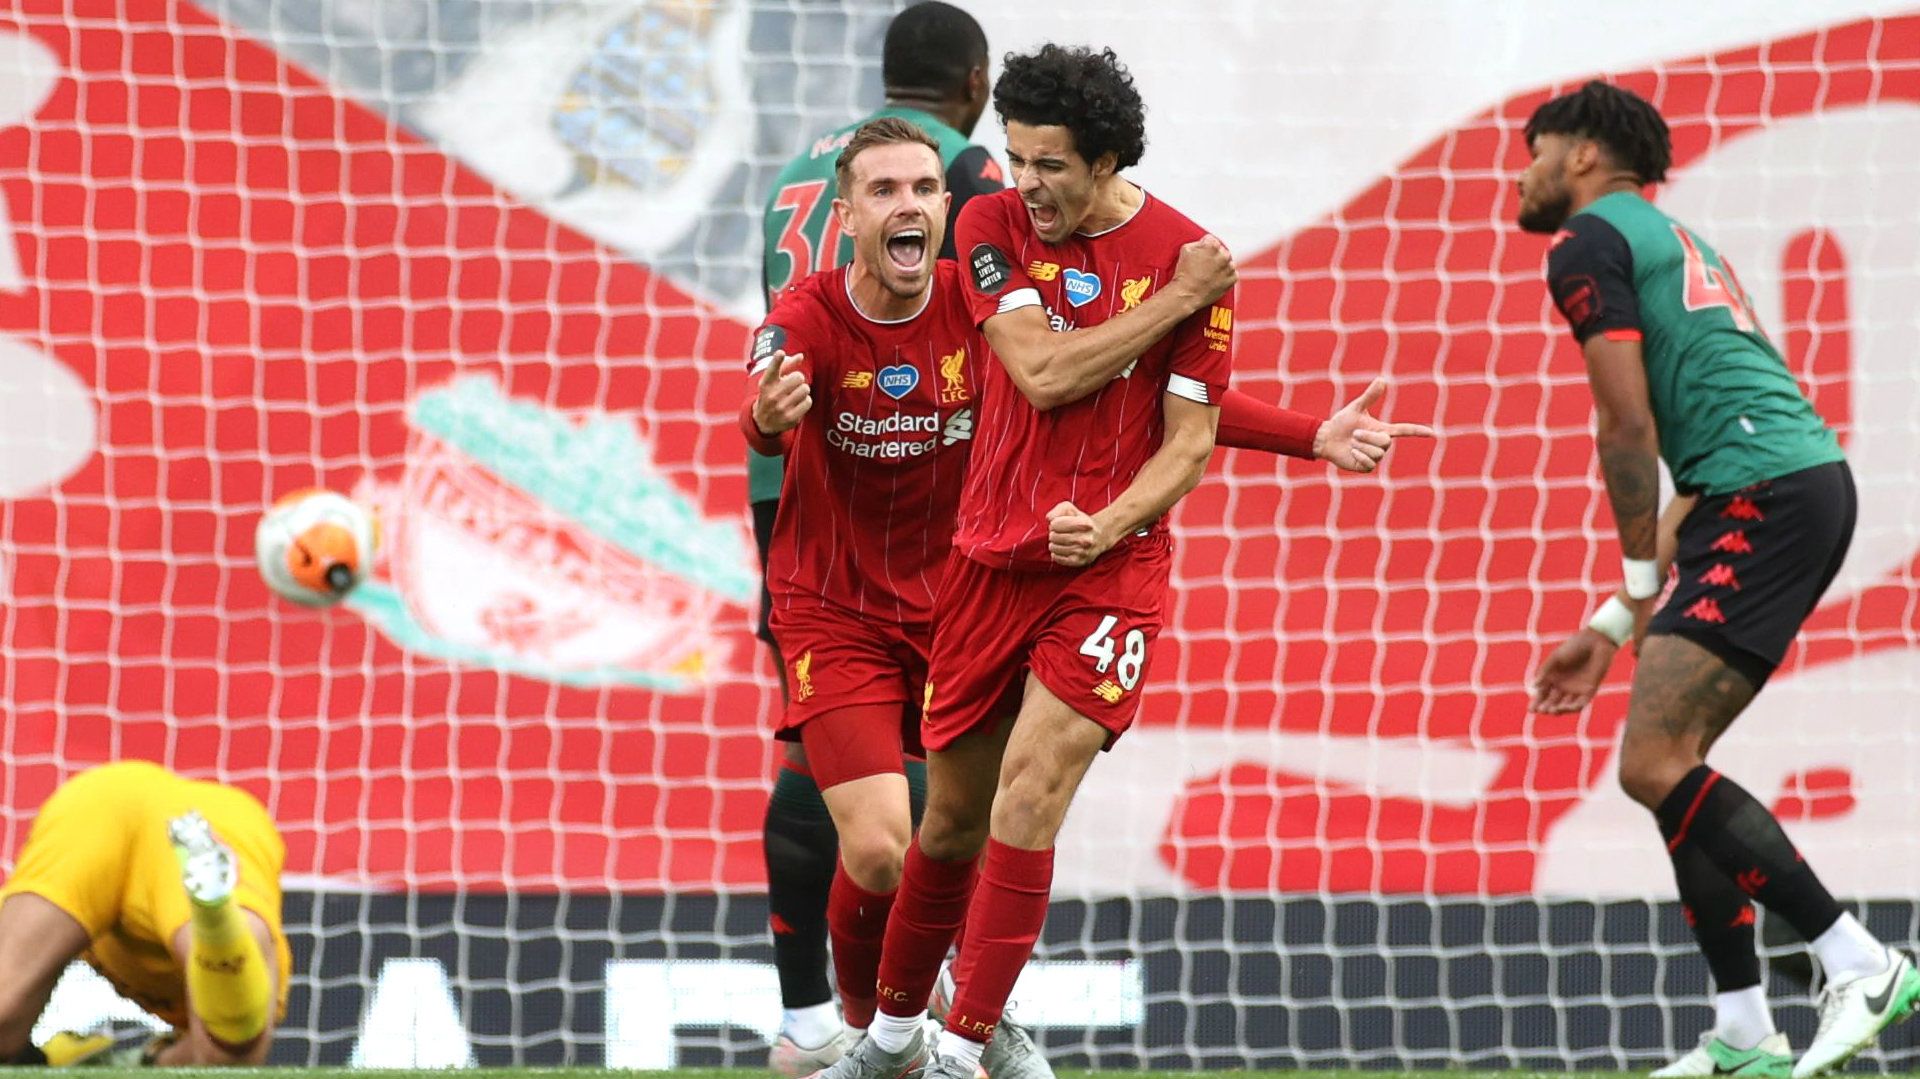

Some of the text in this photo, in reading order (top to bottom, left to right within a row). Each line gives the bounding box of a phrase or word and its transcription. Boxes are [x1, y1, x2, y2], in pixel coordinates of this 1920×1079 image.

[1067, 280, 1092, 294] NHS
[1670, 223, 1768, 337] 4
[885, 375, 911, 387] NHS
[837, 410, 939, 435] Standard
[827, 429, 937, 458] Chartered
[1079, 614, 1145, 691] 48
